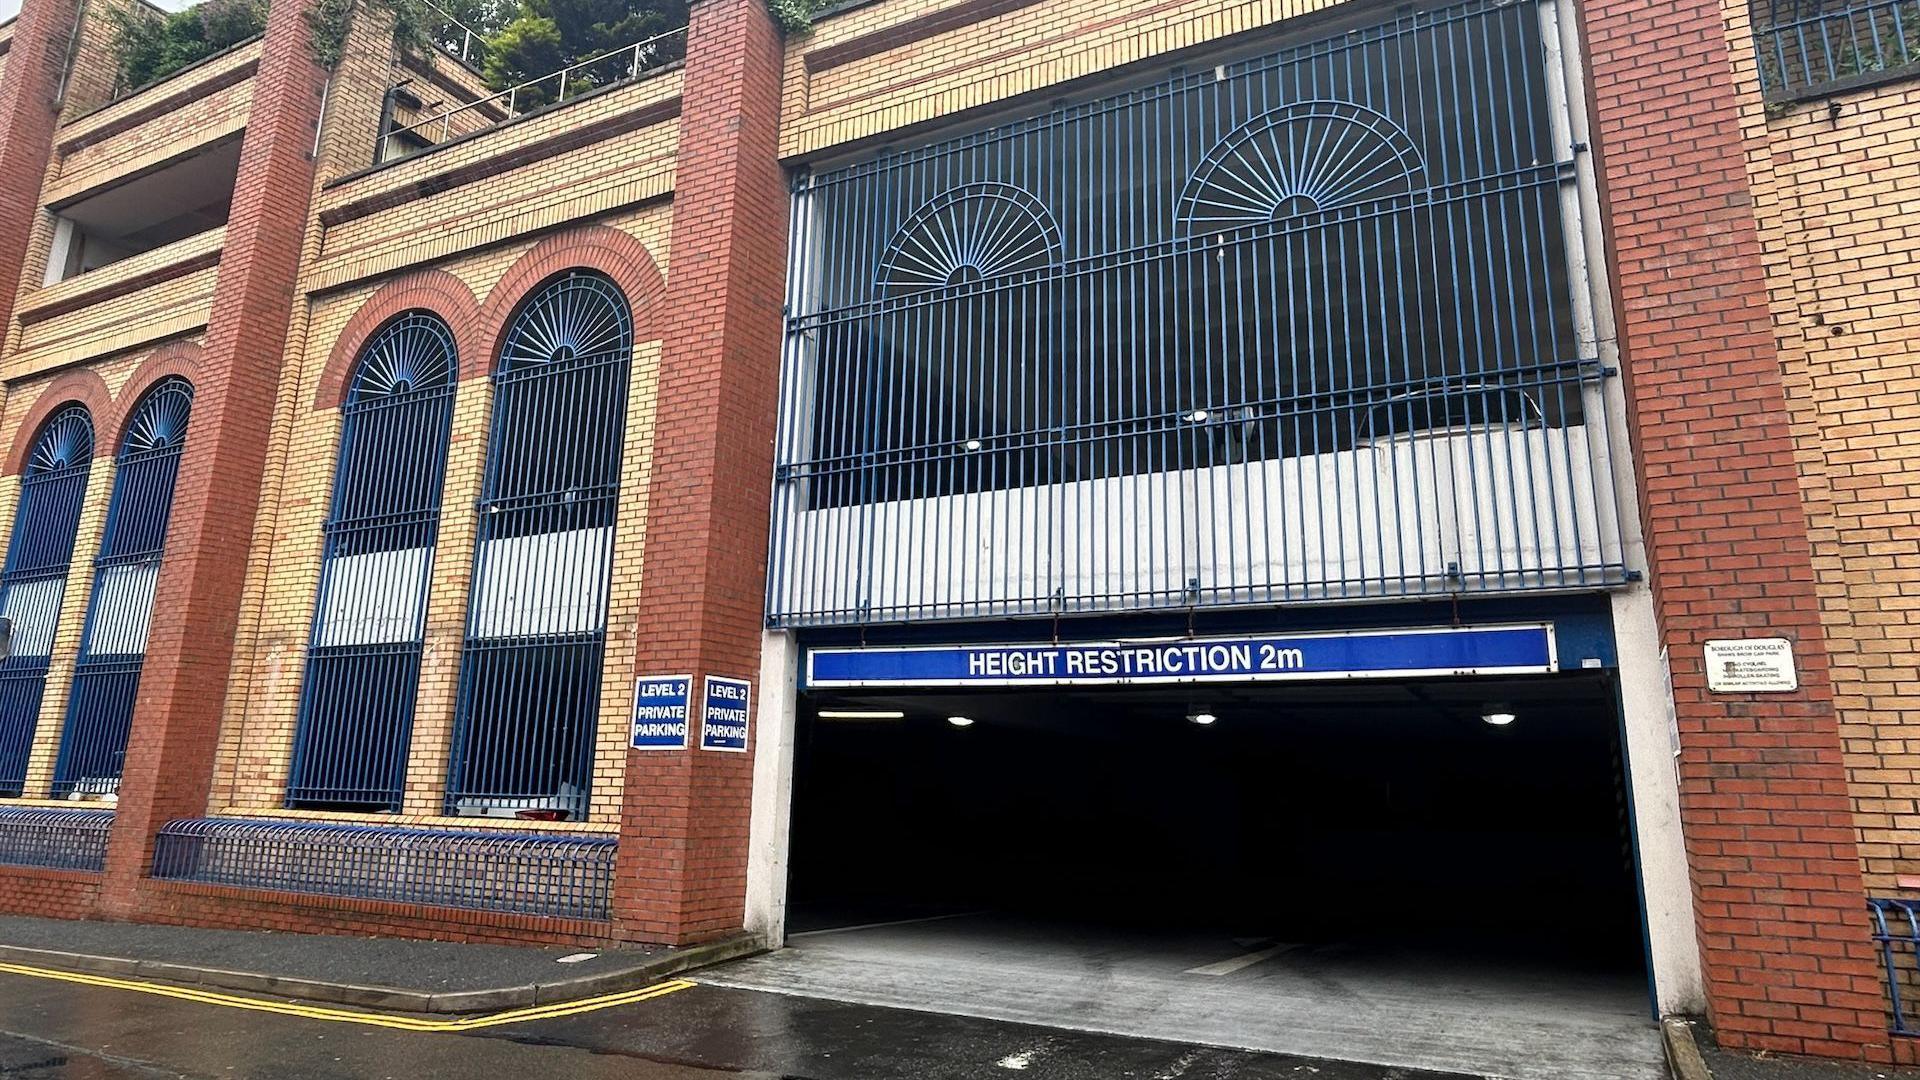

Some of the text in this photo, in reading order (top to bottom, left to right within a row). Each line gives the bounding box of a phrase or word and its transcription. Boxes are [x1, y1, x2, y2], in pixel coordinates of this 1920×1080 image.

[969, 644, 1304, 676] HEIGHT RESTRICTION 2m
[641, 682, 686, 697] LEVEL 2
[710, 684, 747, 701] LEVEL 2
[638, 705, 685, 719] PRIVATE
[708, 706, 746, 722] PRIVATE
[635, 723, 685, 737] PARKING
[705, 723, 746, 739] PARKING
